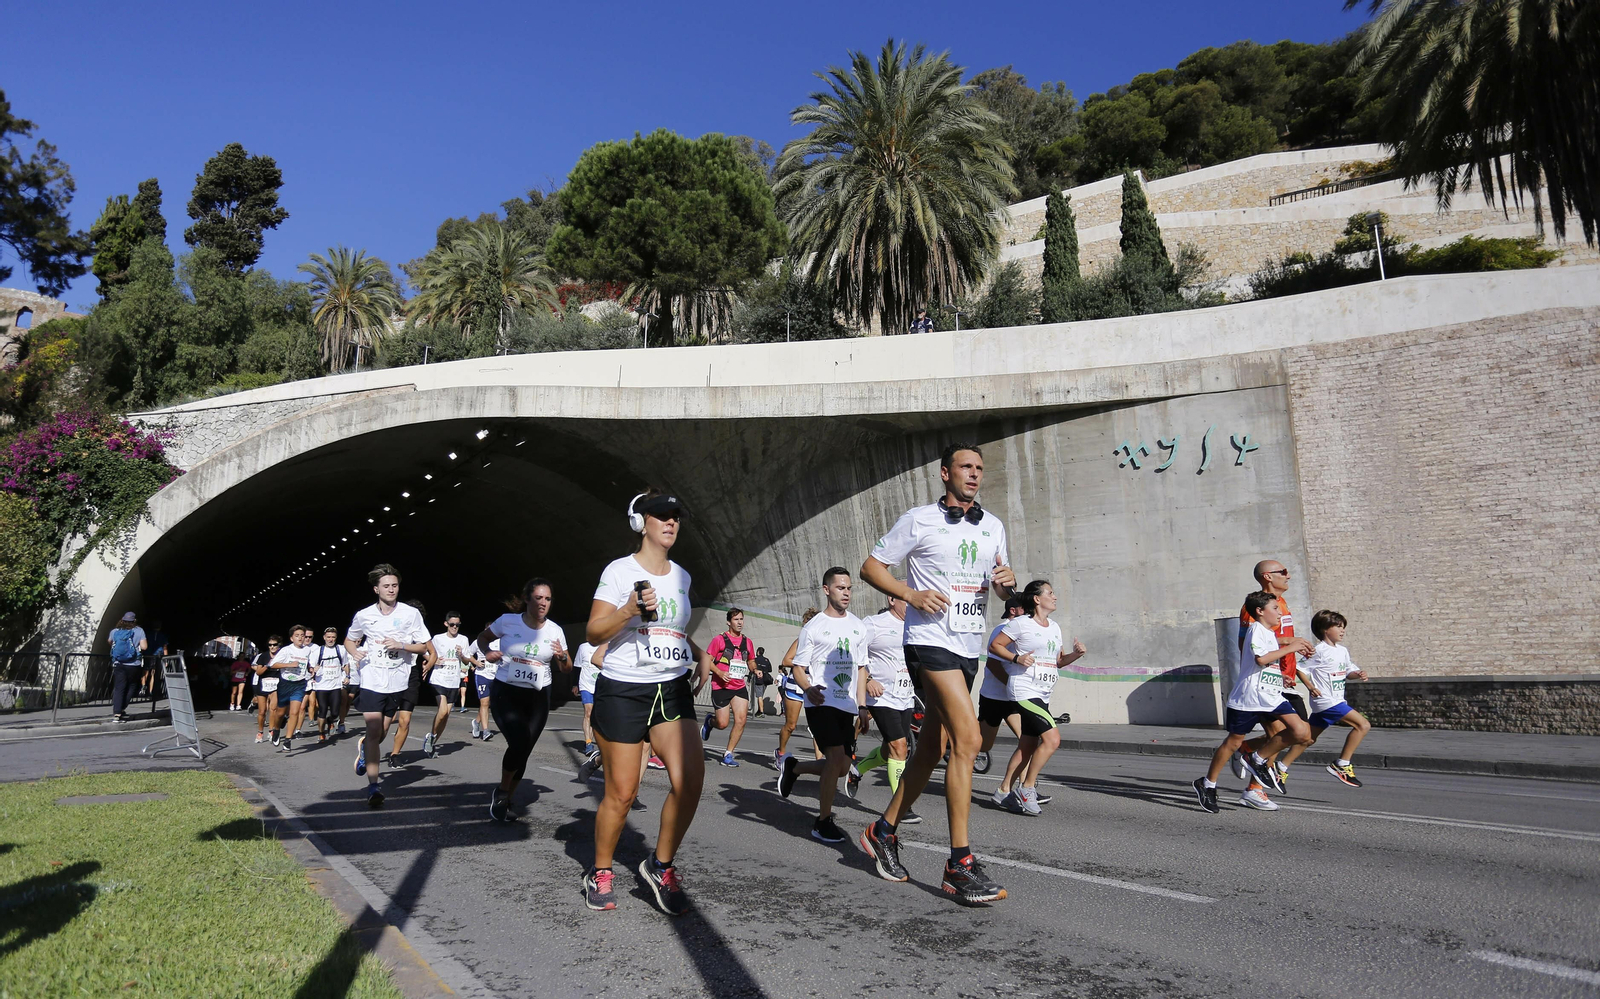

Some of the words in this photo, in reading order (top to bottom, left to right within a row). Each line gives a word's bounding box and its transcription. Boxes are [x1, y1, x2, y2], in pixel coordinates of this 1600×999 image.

[377, 649, 399, 660] 3154
[644, 645, 690, 662] 18064
[515, 669, 538, 682] 3141
